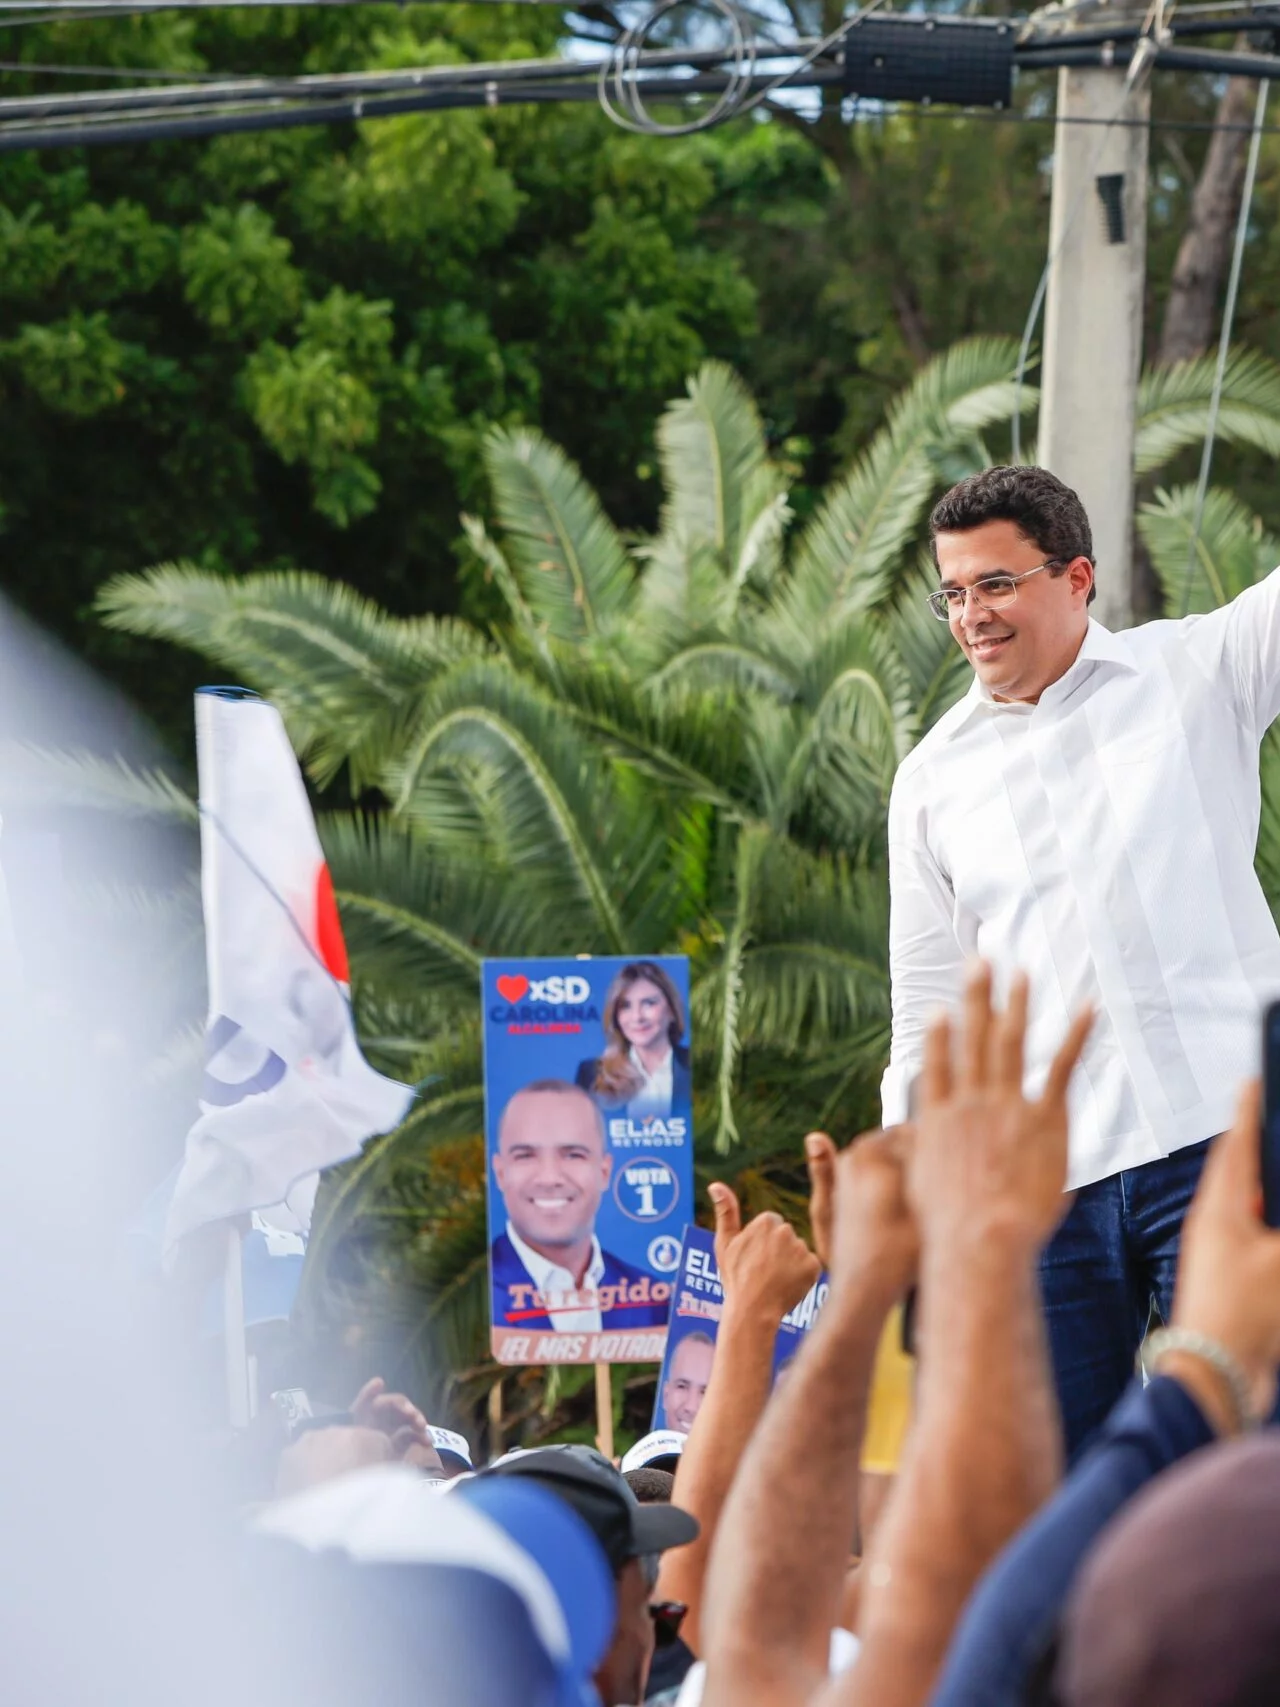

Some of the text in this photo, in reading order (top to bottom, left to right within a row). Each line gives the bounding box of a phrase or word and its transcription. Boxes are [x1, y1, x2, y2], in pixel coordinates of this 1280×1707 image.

[489, 1005, 601, 1024] CAROLINA
[612, 1137, 685, 1148] REYNOSO
[624, 1167, 671, 1186] VOTA
[633, 1184, 659, 1216] 1
[562, 1276, 675, 1312] regido
[685, 1273, 725, 1297] REYN
